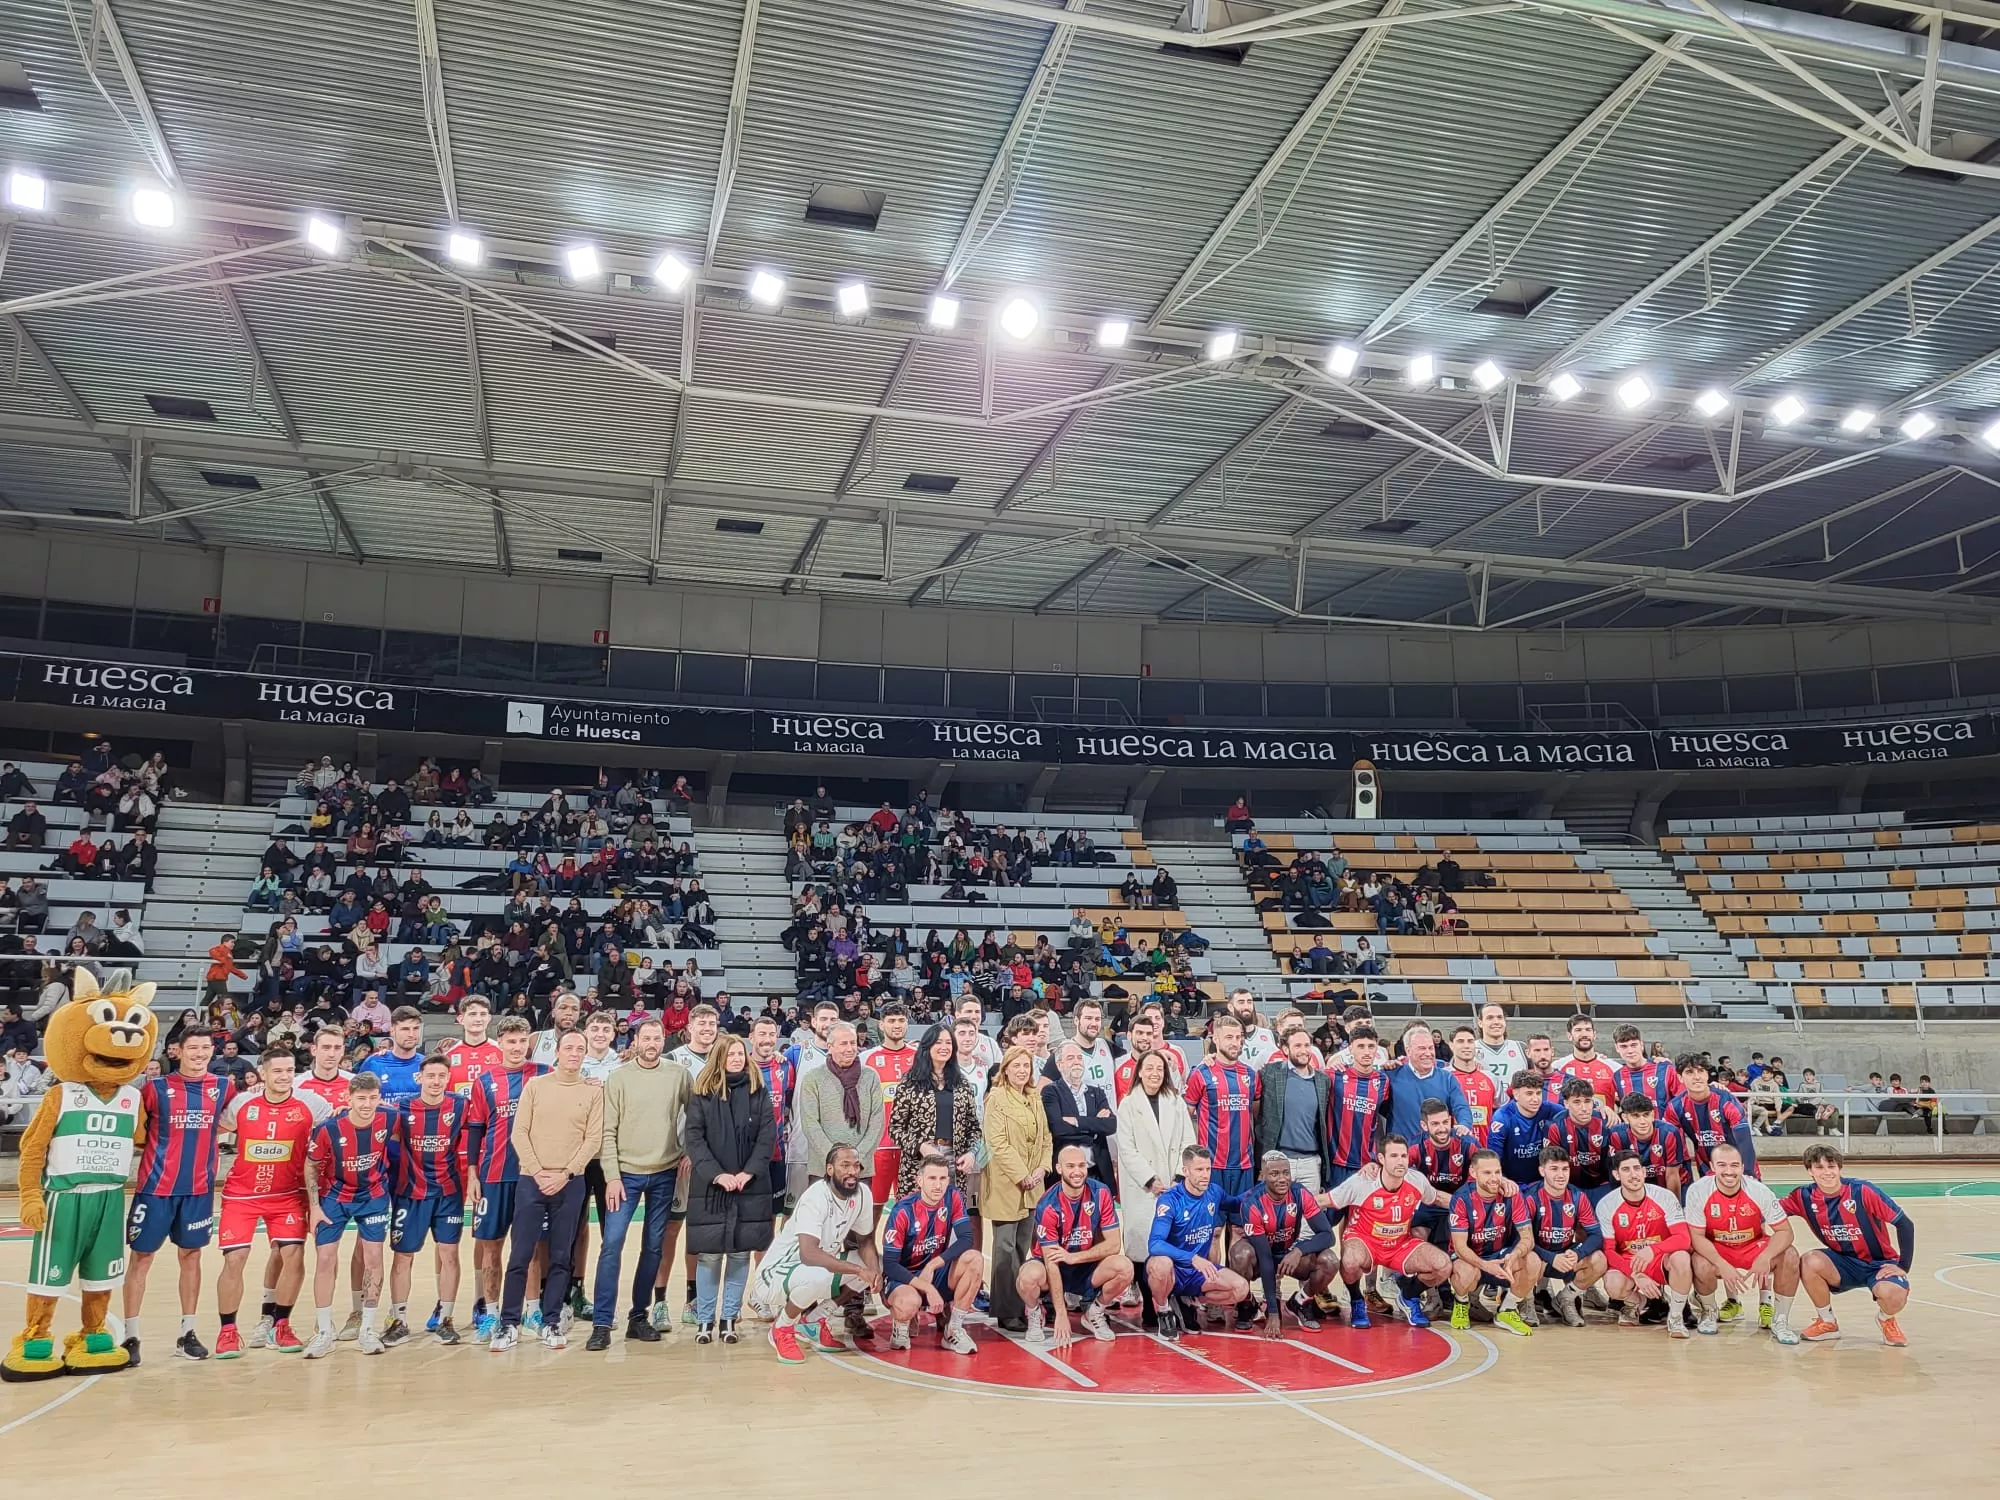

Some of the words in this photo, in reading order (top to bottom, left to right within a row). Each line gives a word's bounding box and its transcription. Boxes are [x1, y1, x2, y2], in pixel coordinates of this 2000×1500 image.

[42, 664, 194, 695] Huesca
[72, 693, 96, 706] La
[258, 682, 394, 710] Huesca
[280, 709, 302, 720] La
[550, 704, 670, 725] Ayuntamiento
[550, 723, 570, 736] de
[576, 724, 641, 740] Huesca
[771, 717, 886, 740] Huesca
[933, 724, 1042, 746] Huesca
[1842, 722, 1976, 748] Huesca
[794, 741, 812, 752] La
[1076, 734, 1195, 758] Huesca
[1202, 740, 1236, 758] La
[1669, 732, 1790, 752] Huesca
[952, 748, 969, 758] La
[1370, 740, 1490, 762] Huesca
[1496, 744, 1531, 762] La
[1867, 751, 1888, 762] La
[1696, 757, 1715, 768] La
[468, 1064, 482, 1082] 22
[894, 1064, 902, 1079] 5
[1088, 1064, 1104, 1080] 16
[1489, 1063, 1508, 1076] 27
[1342, 1097, 1376, 1110] Huesca
[1466, 1090, 1478, 1105] 15
[86, 1114, 118, 1132] 00
[168, 1113, 214, 1124] Huesca
[266, 1121, 276, 1140] 9
[77, 1137, 122, 1150] Lobe
[254, 1146, 282, 1154] Bada
[410, 1138, 450, 1147] Huesca
[76, 1154, 120, 1166] Huesca
[132, 1203, 148, 1224] 5
[394, 1208, 408, 1228] 2
[1390, 1206, 1402, 1222] 10
[1821, 1227, 1863, 1236] Huesca
